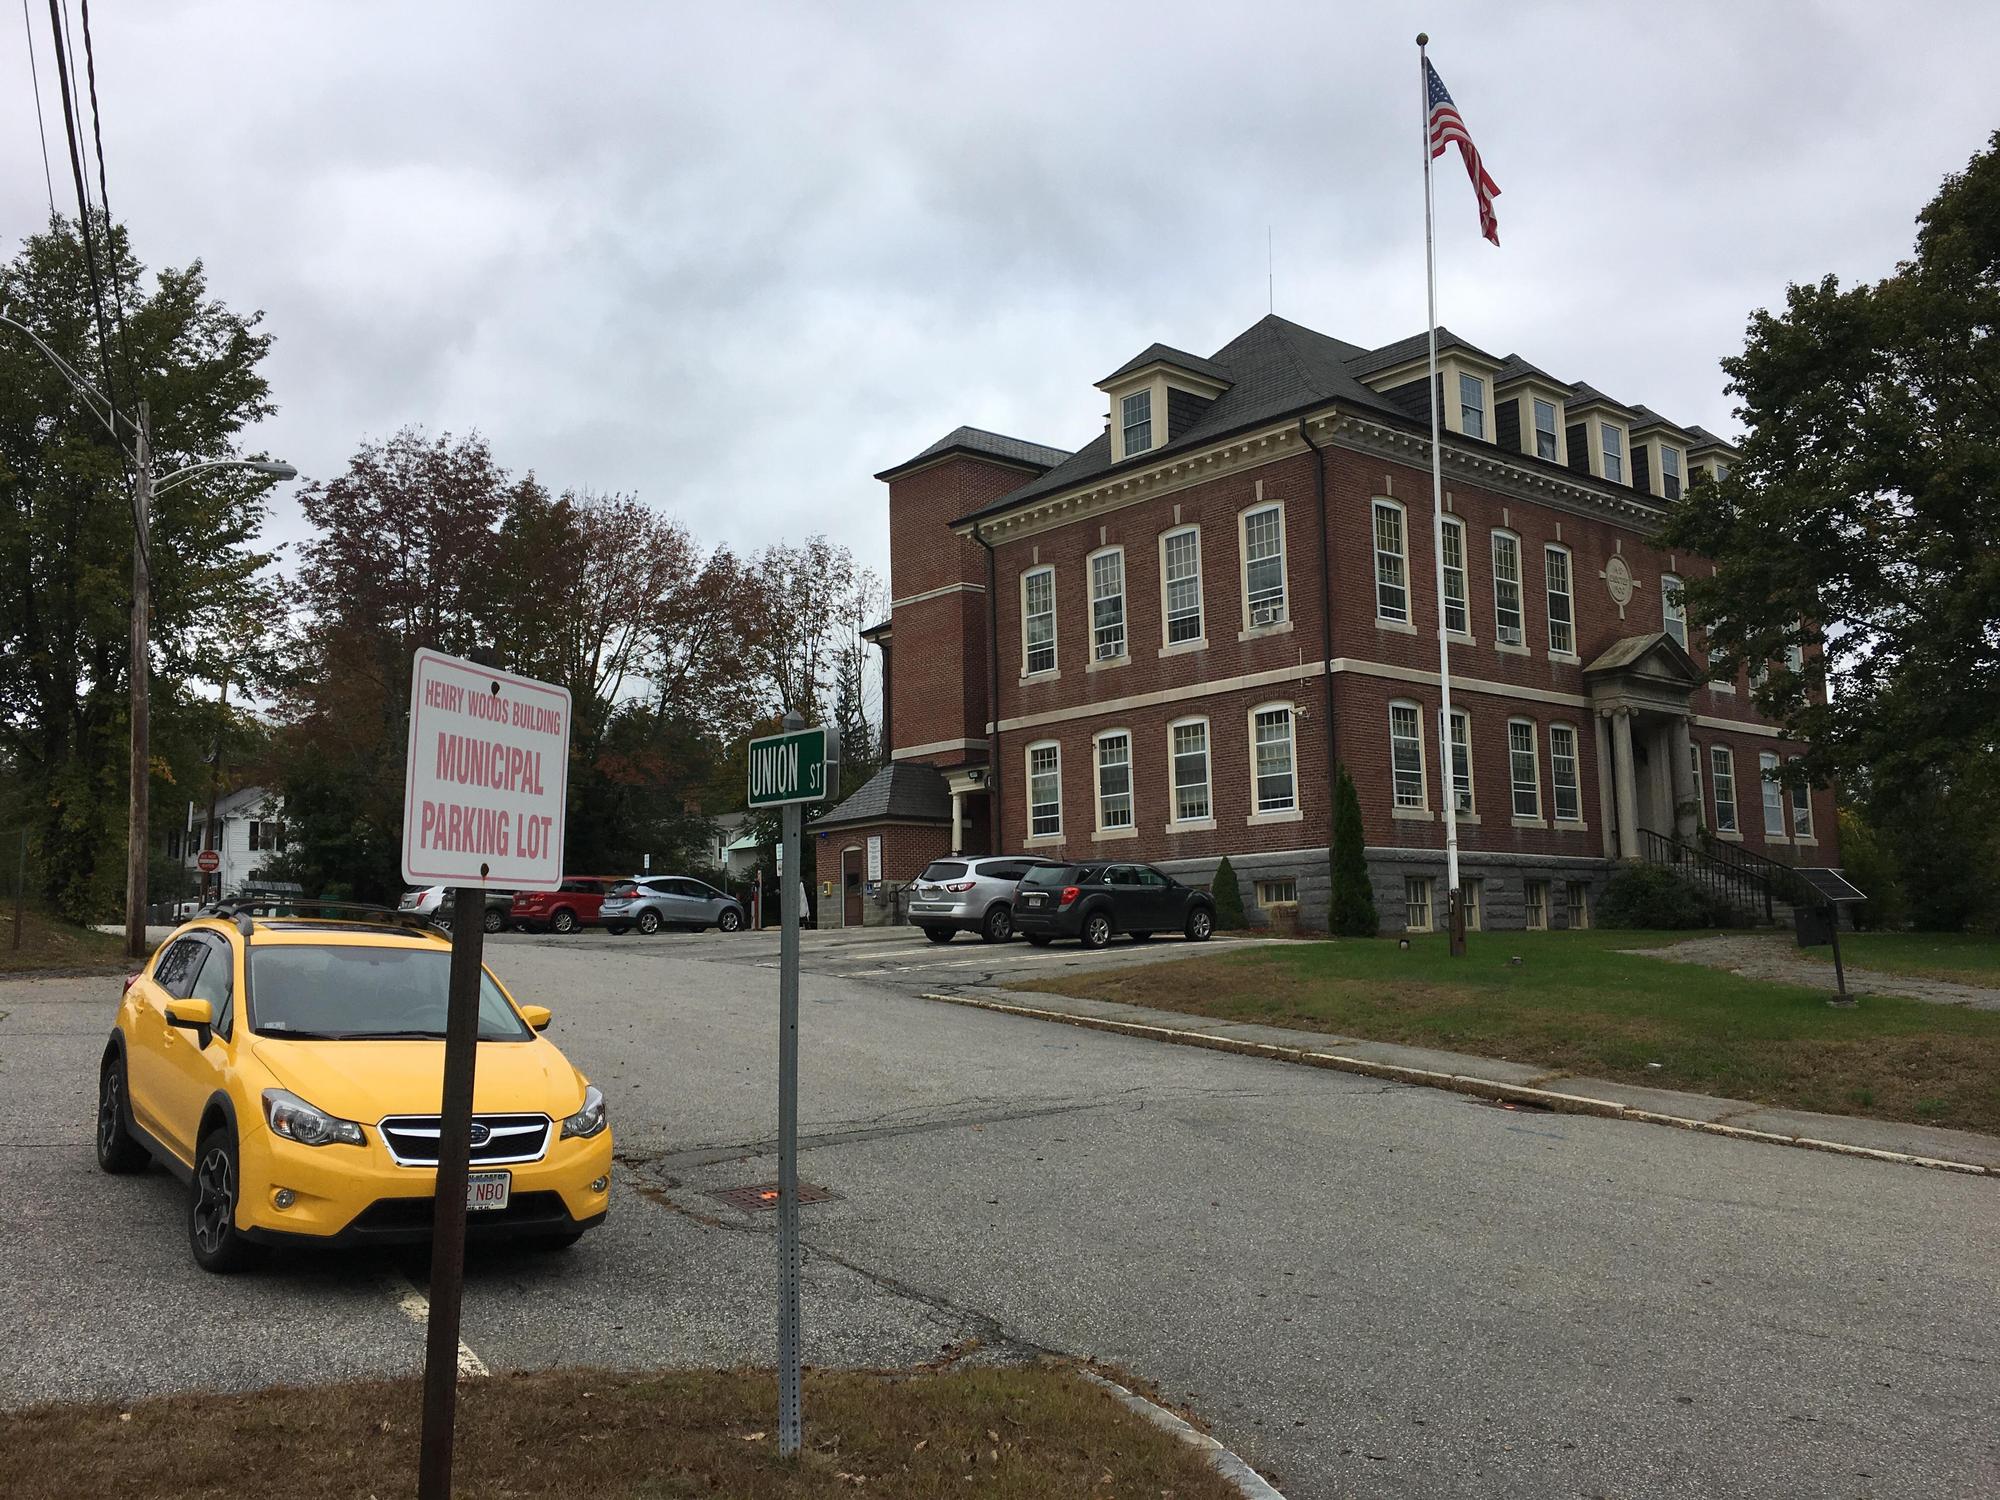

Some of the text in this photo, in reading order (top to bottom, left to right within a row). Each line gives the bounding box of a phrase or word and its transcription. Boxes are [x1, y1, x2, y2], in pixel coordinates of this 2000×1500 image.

[425, 679, 561, 736] HENRY WOODS BUILDING
[436, 732, 544, 796] MUNICIPAL
[752, 742, 821, 797] UNION ST
[420, 800, 553, 860] PARKING LOT
